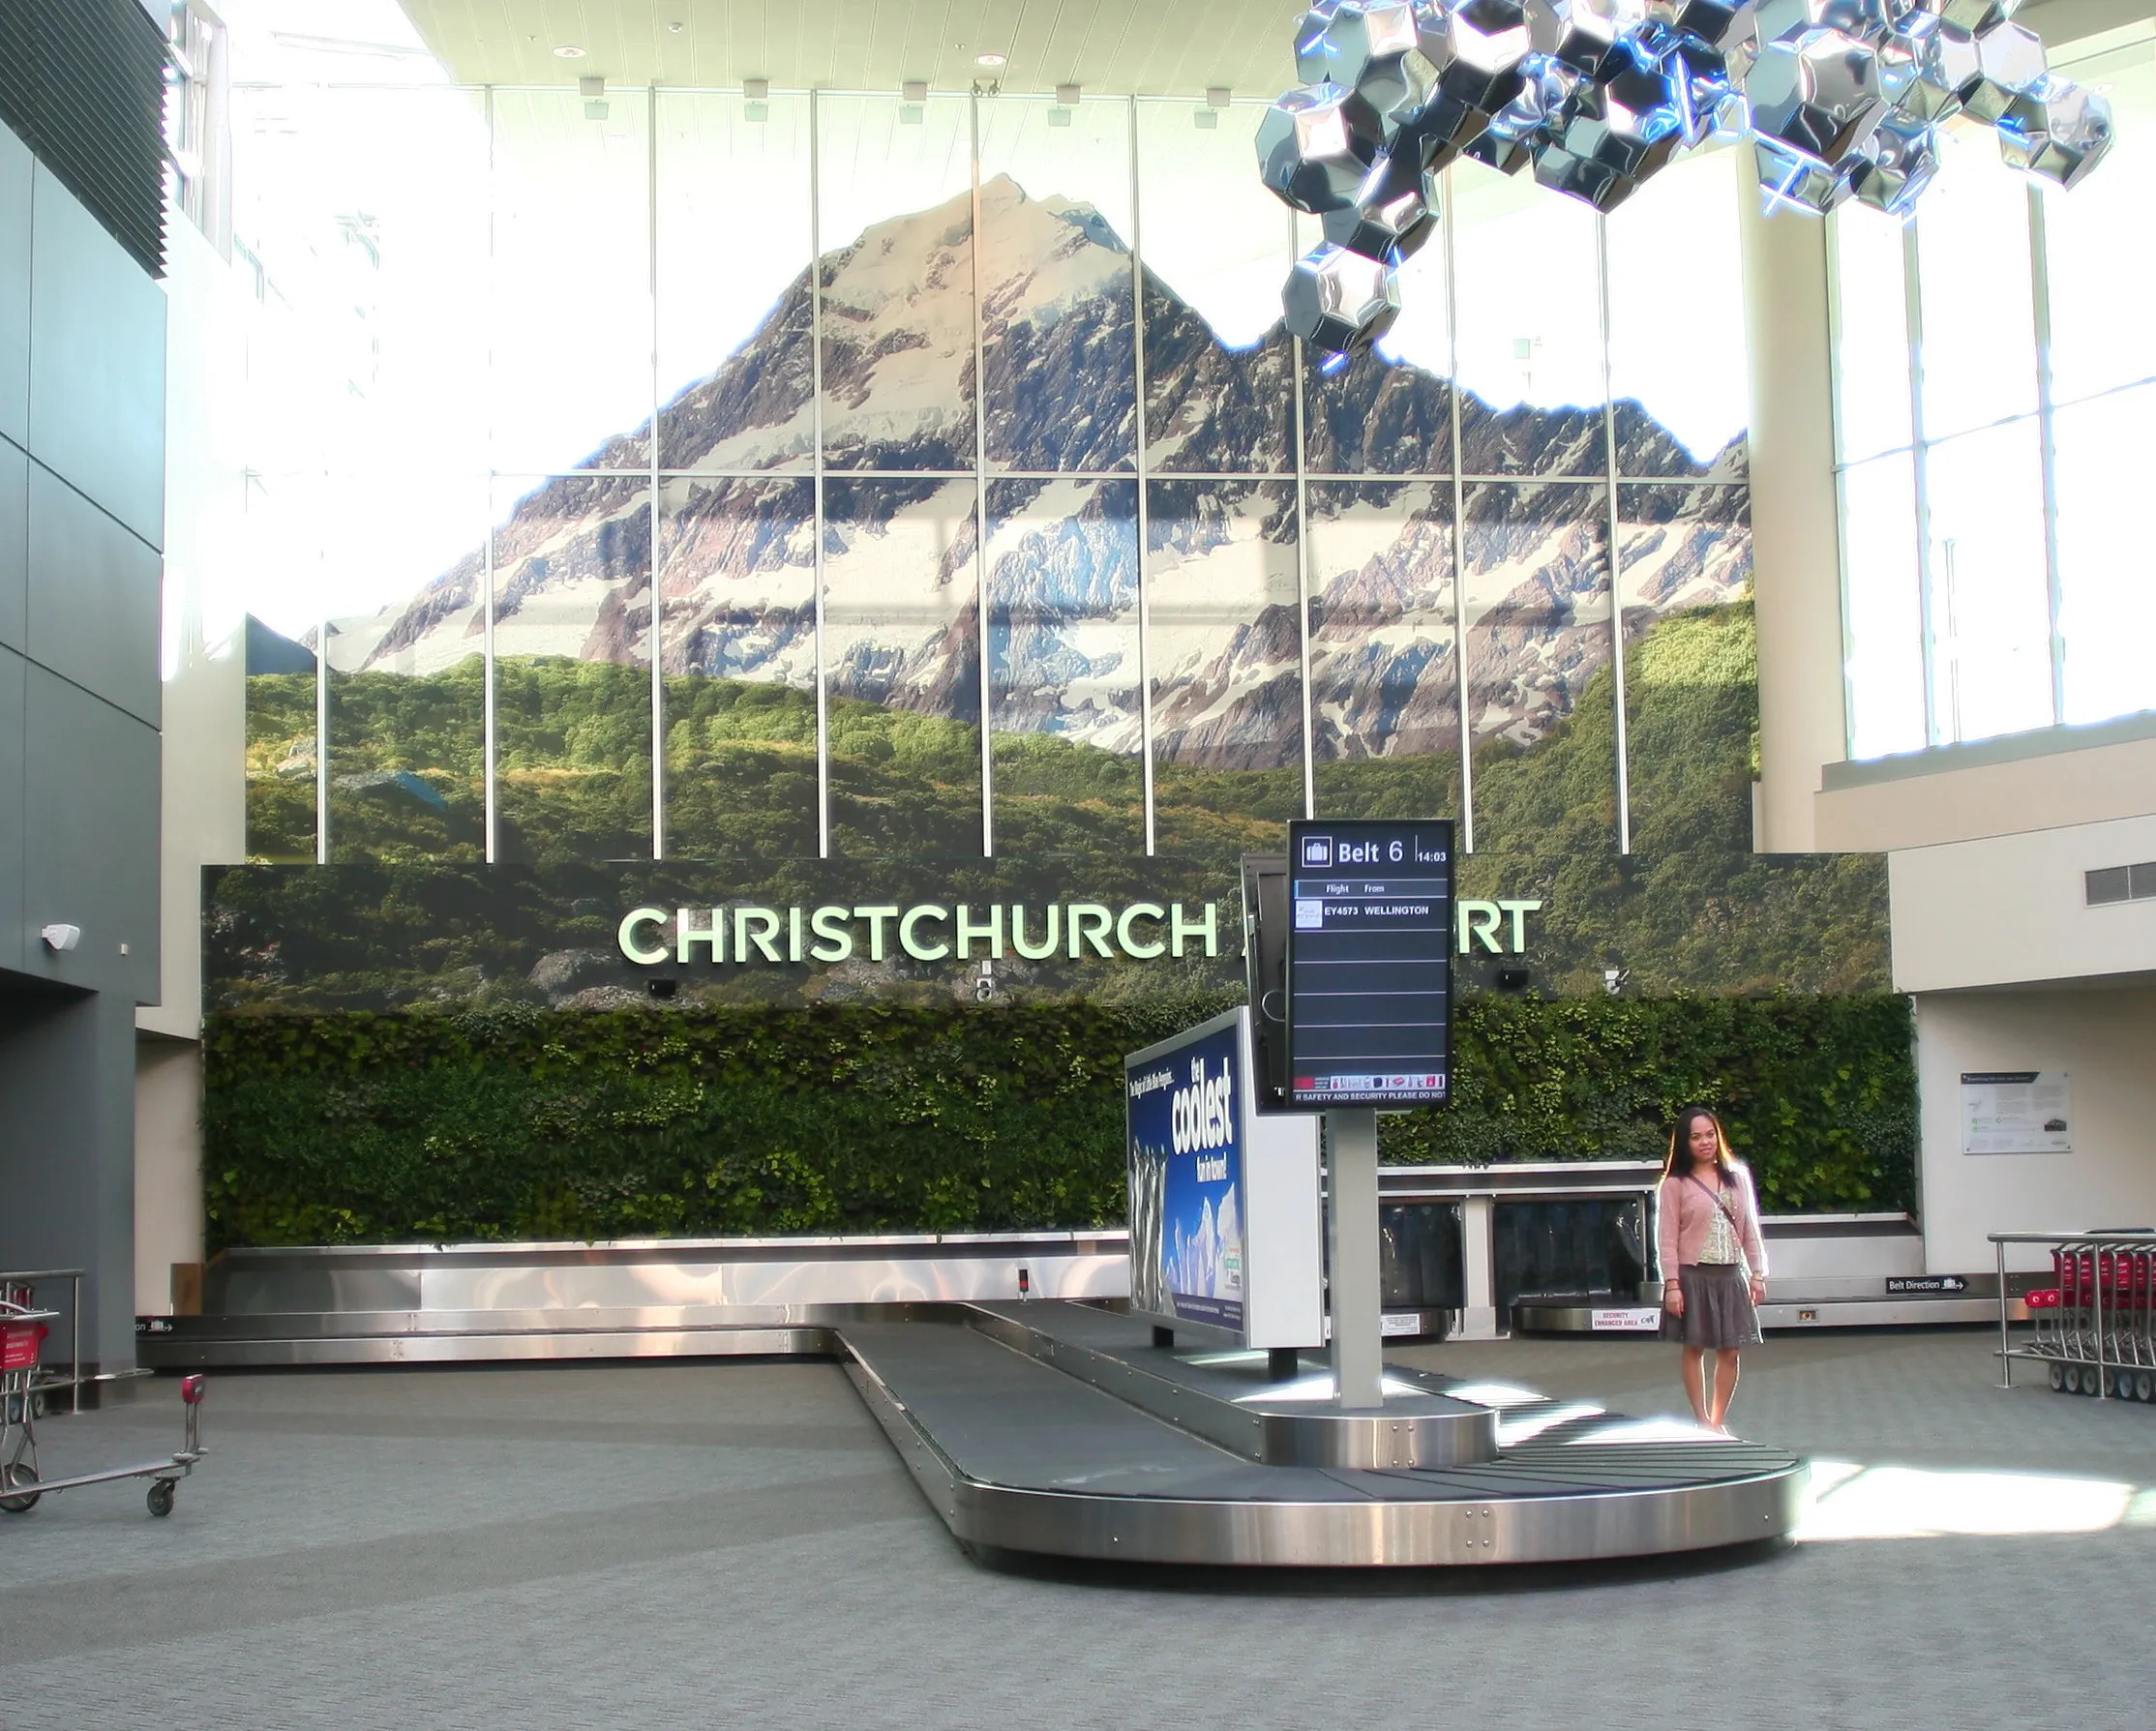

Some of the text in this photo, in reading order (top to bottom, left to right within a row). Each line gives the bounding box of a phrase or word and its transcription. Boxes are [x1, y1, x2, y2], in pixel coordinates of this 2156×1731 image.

[1338, 840, 1403, 863] Belt 6
[1418, 851, 1447, 862] 14:03
[1326, 884, 1385, 895] Flight From
[1364, 906, 1430, 915] WELLINGTON
[616, 902, 1218, 965] CHRISTCHURCH
[1303, 1092, 1333, 1101] SAFETY
[1350, 1091, 1388, 1100] SECURITY
[1419, 1090, 1430, 1099] DO
[1171, 1057, 1234, 1155] coolest
[1889, 1280, 1939, 1291] Belt Direction
